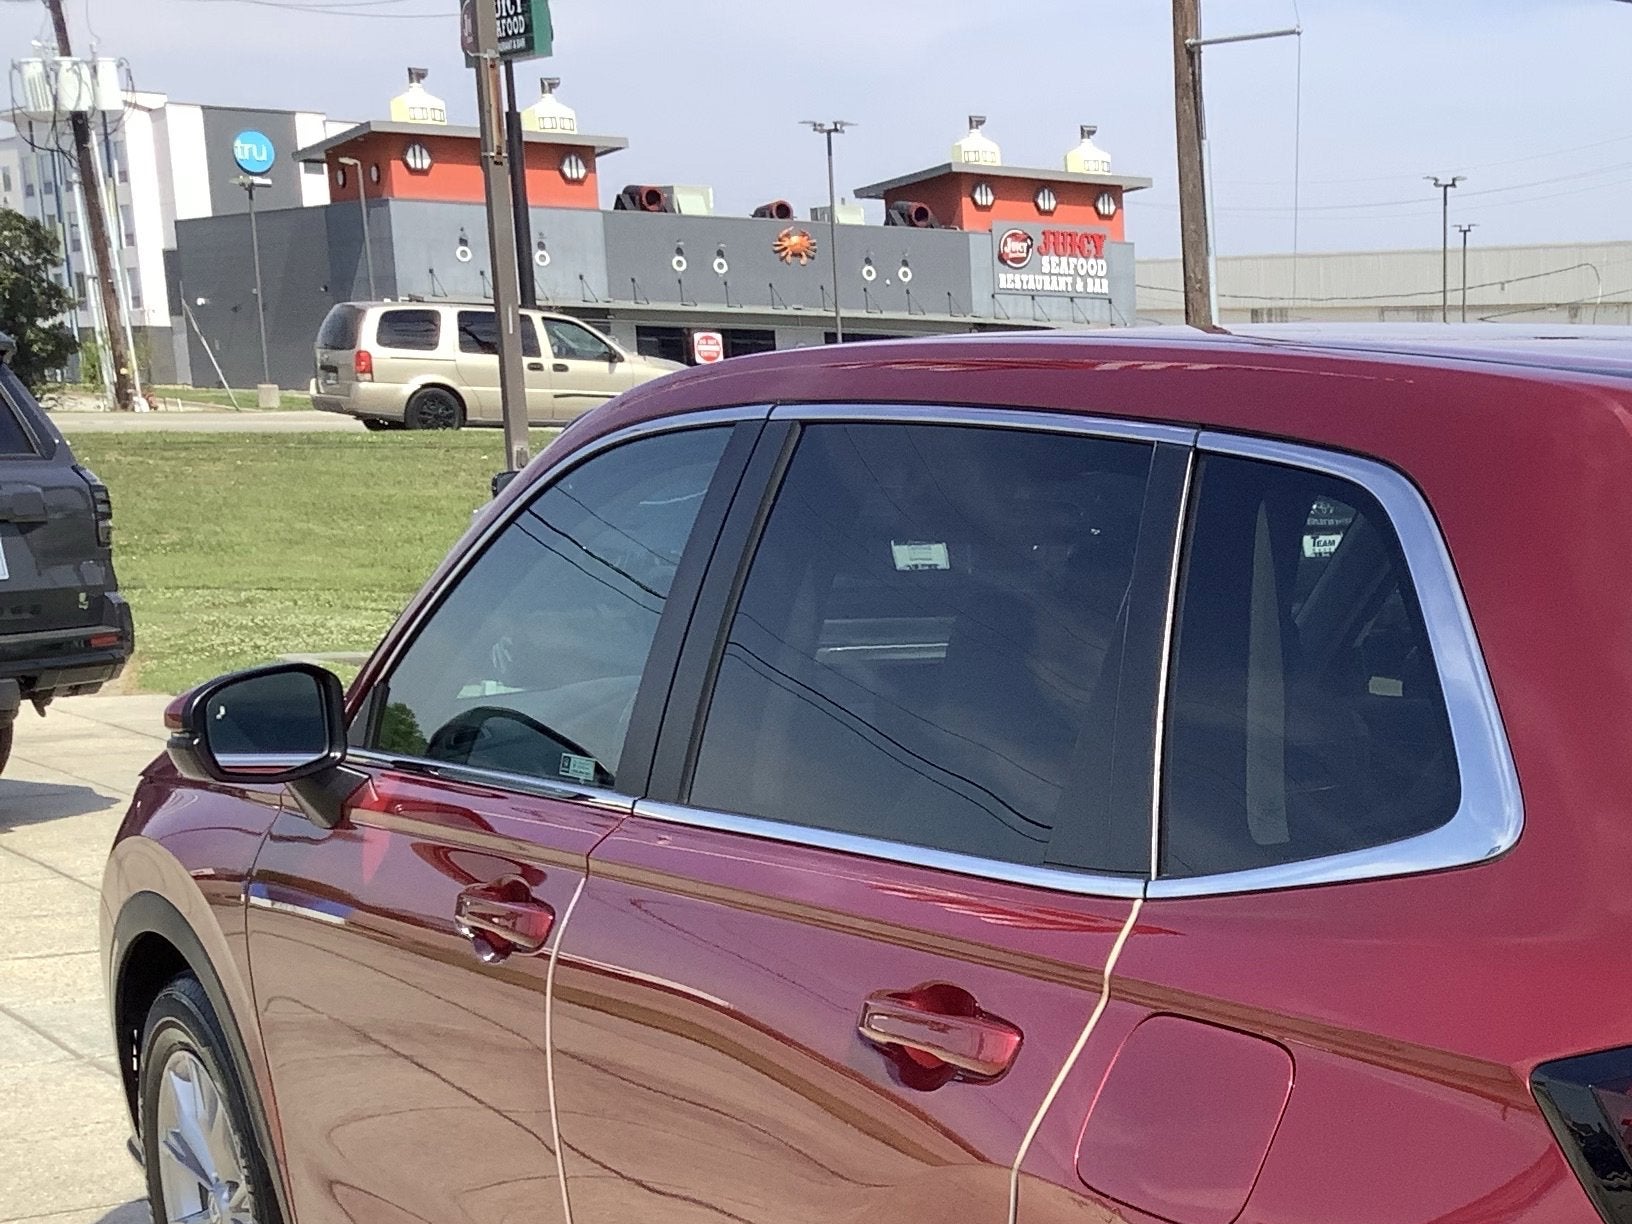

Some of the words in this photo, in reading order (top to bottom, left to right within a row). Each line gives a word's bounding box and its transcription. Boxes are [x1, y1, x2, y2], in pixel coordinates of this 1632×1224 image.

[234, 138, 267, 161] tru
[1038, 230, 1106, 258] JUICY
[1041, 255, 1108, 277] SEAFOOD
[998, 273, 1073, 292] RESTAURANT
[1075, 277, 1084, 293] &
[1086, 278, 1109, 294] BAR
